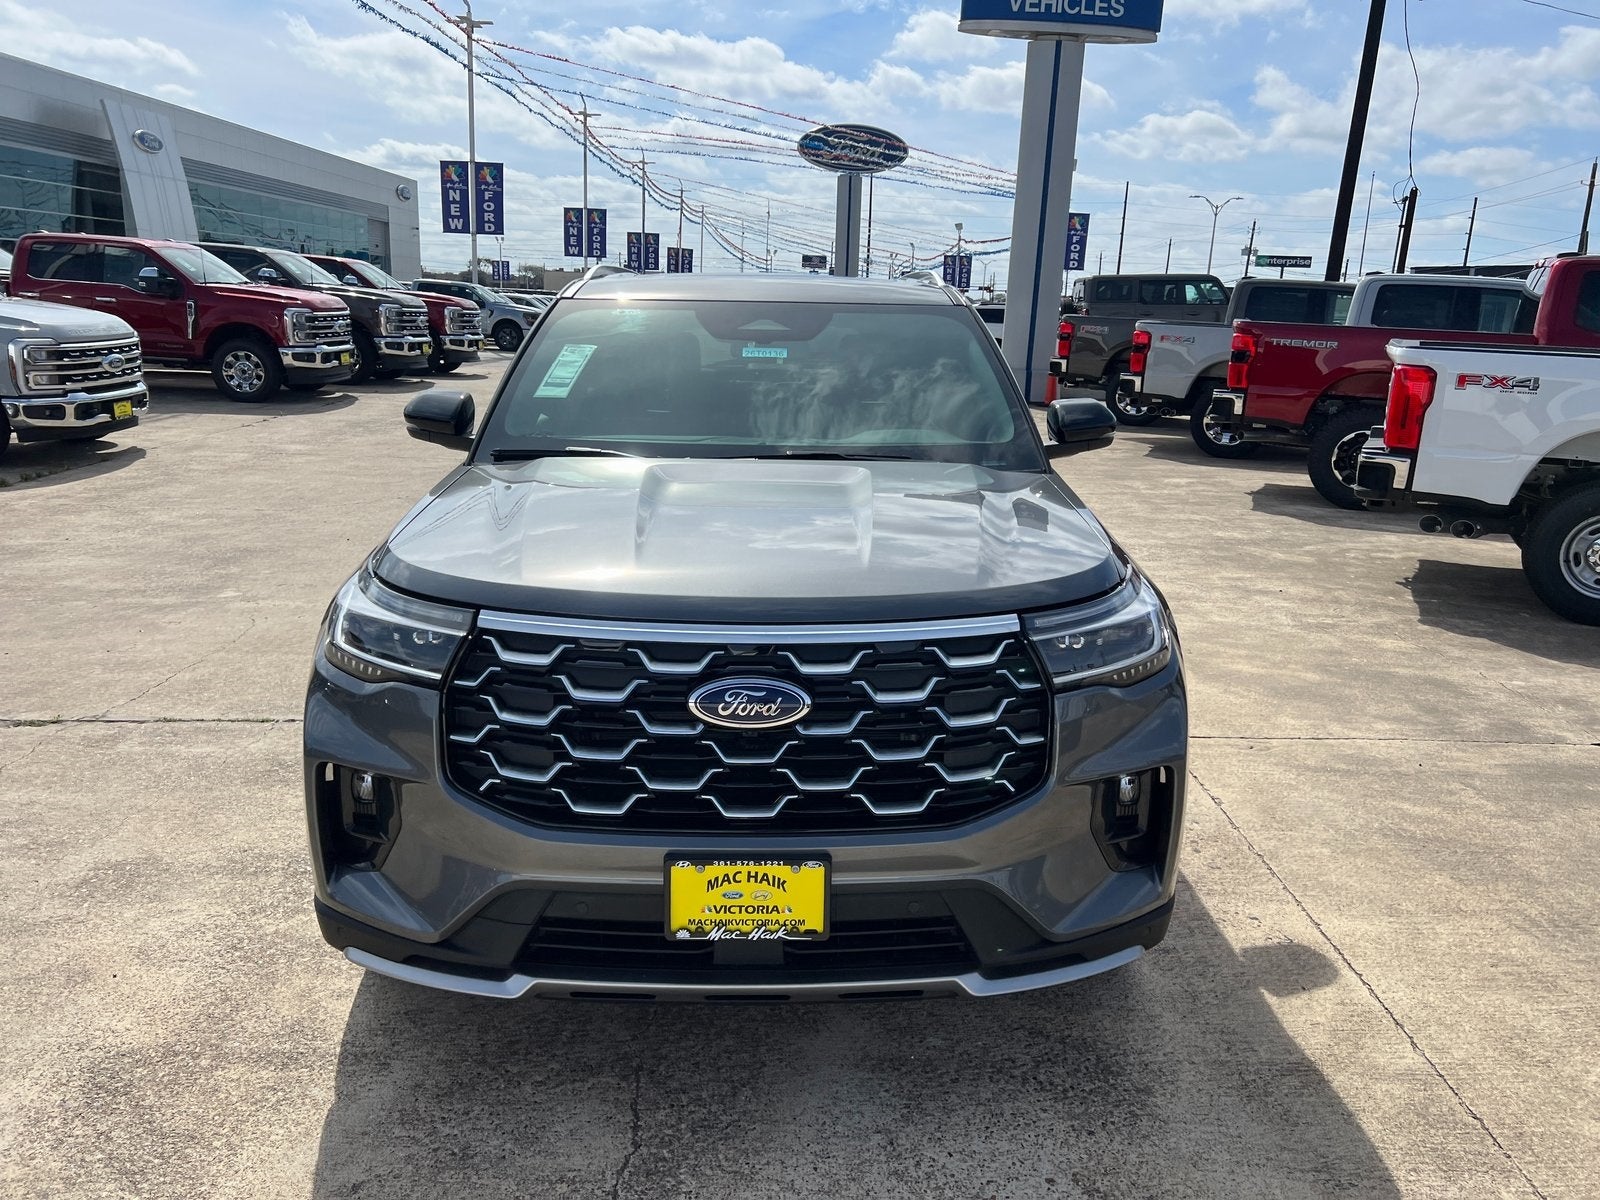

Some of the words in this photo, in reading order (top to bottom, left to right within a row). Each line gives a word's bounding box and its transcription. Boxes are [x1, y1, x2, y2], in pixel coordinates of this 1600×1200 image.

[1009, 0, 1125, 17] VEHICLES
[448, 189, 464, 230] NEW
[482, 191, 495, 232] FORD
[568, 227, 579, 255] NEW
[592, 228, 600, 256] FORD
[630, 246, 639, 268] NEW
[1069, 235, 1080, 268] FORD
[1260, 257, 1311, 266] enterprise
[1160, 334, 1196, 344] FX4
[1270, 338, 1339, 349] TREMOR
[1454, 372, 1540, 391] FX4
[718, 689, 783, 717] Ford
[706, 870, 743, 893] MAC
[746, 870, 788, 893] HAIK
[712, 904, 781, 915] VICTORIA
[687, 918, 806, 927] MACHAIKVICTORIA.COM
[706, 926, 747, 941] Mac
[747, 926, 790, 941] Haik
